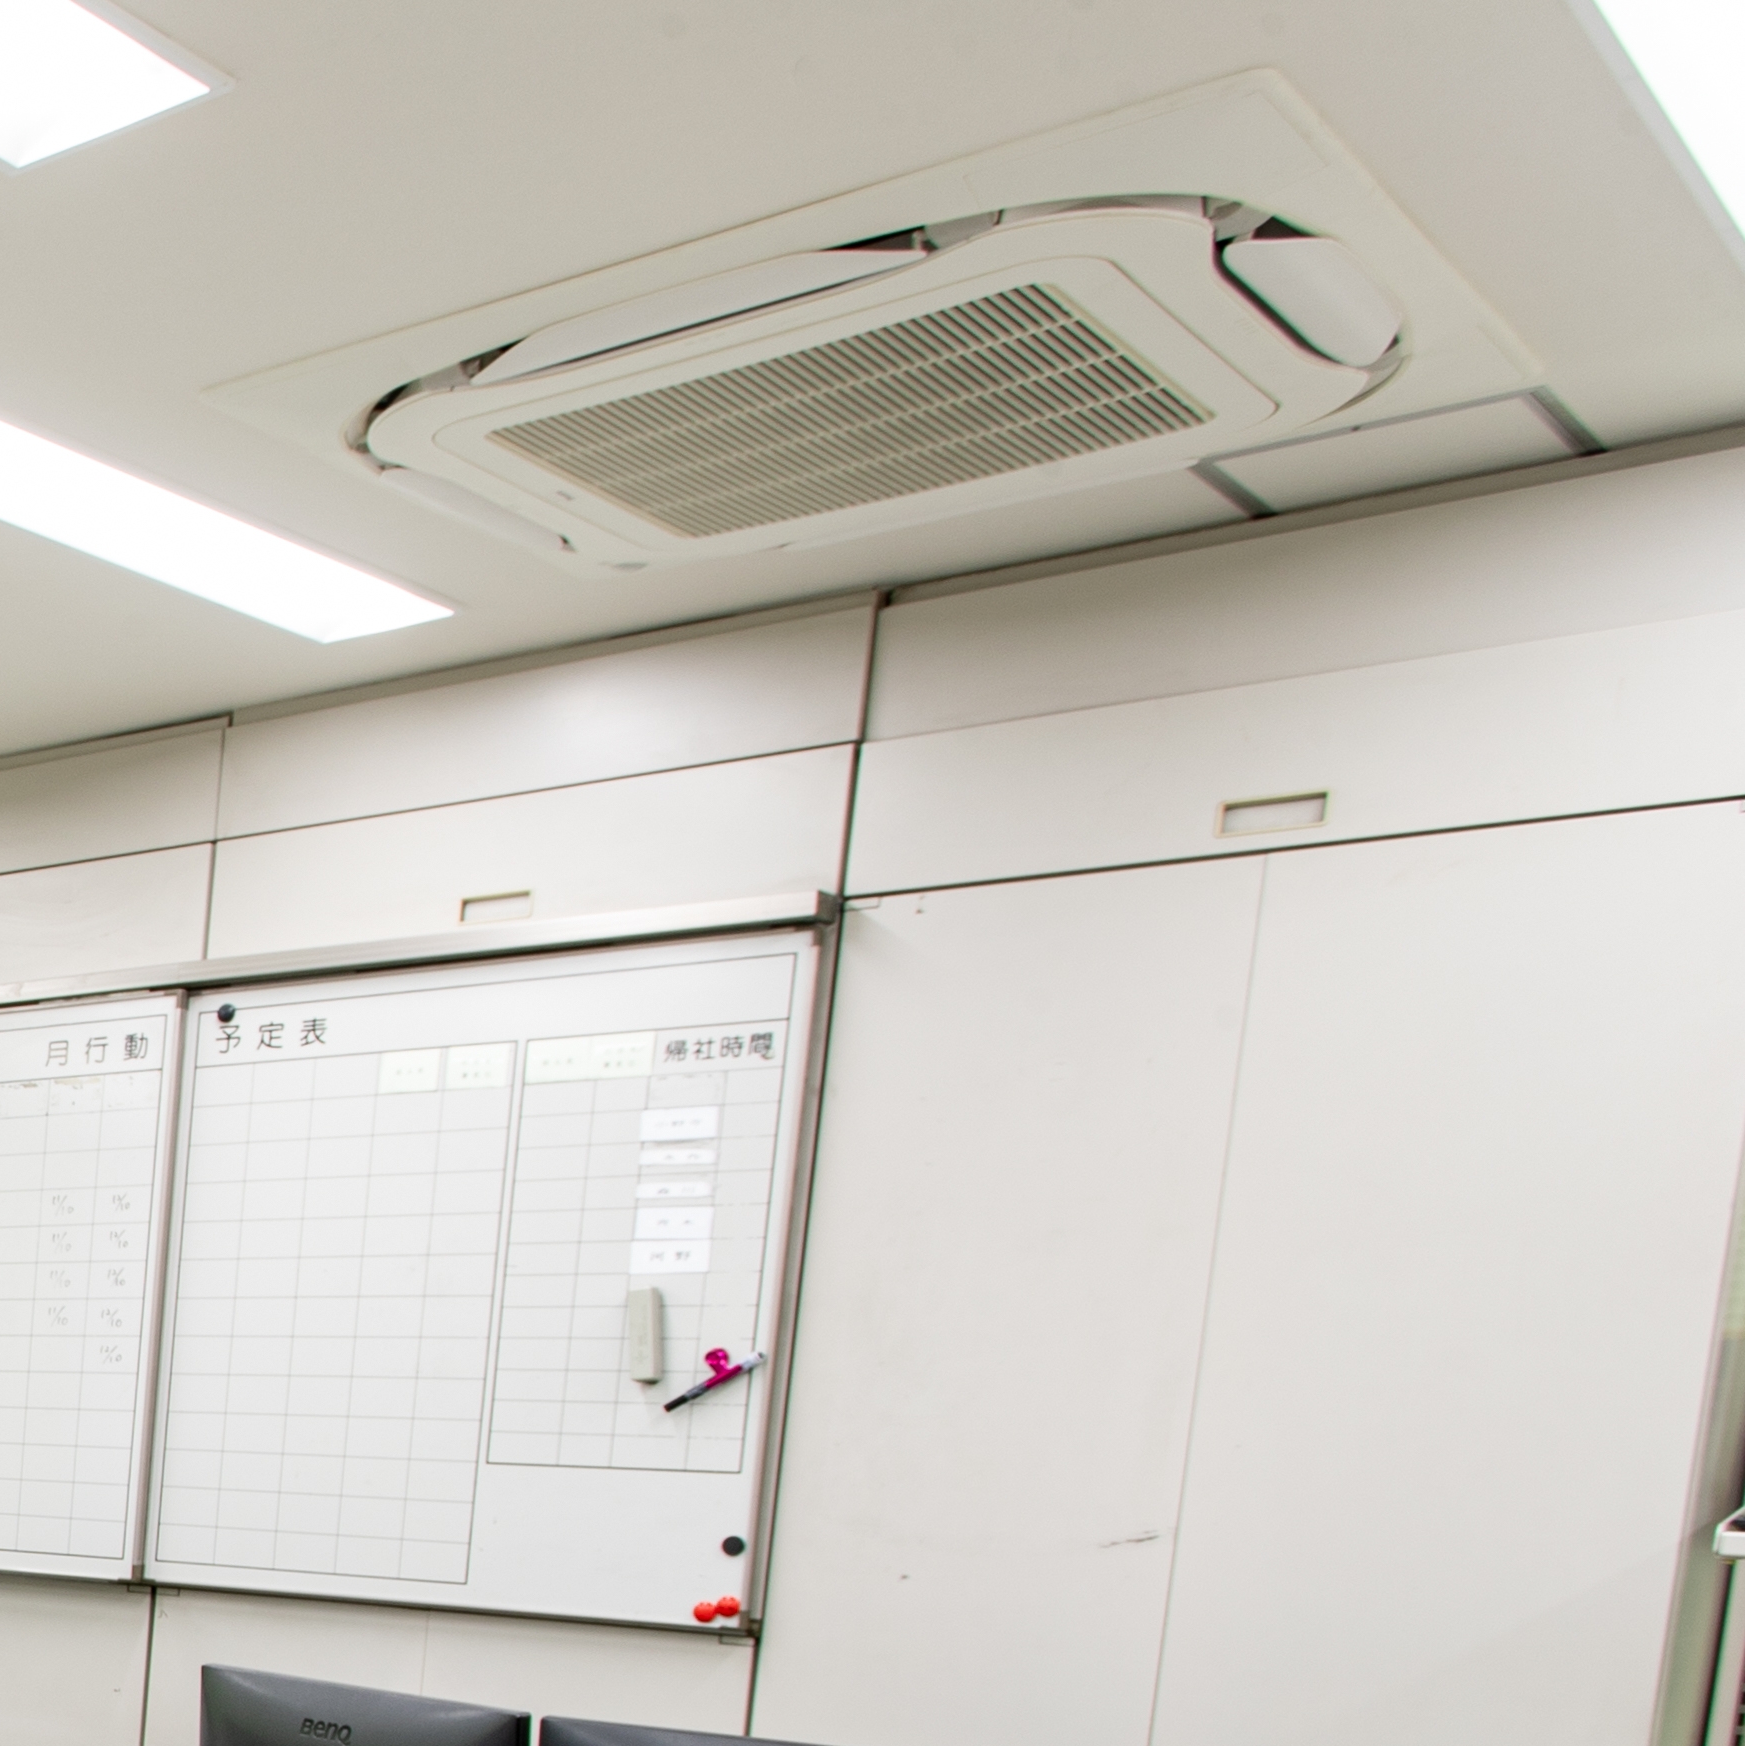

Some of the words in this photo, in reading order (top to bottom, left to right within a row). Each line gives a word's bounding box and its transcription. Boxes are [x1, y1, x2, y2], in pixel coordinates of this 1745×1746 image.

[45, 1032, 150, 1067] 月行動
[215, 1017, 329, 1054] 予定表
[663, 1031, 776, 1063] 帰社時間
